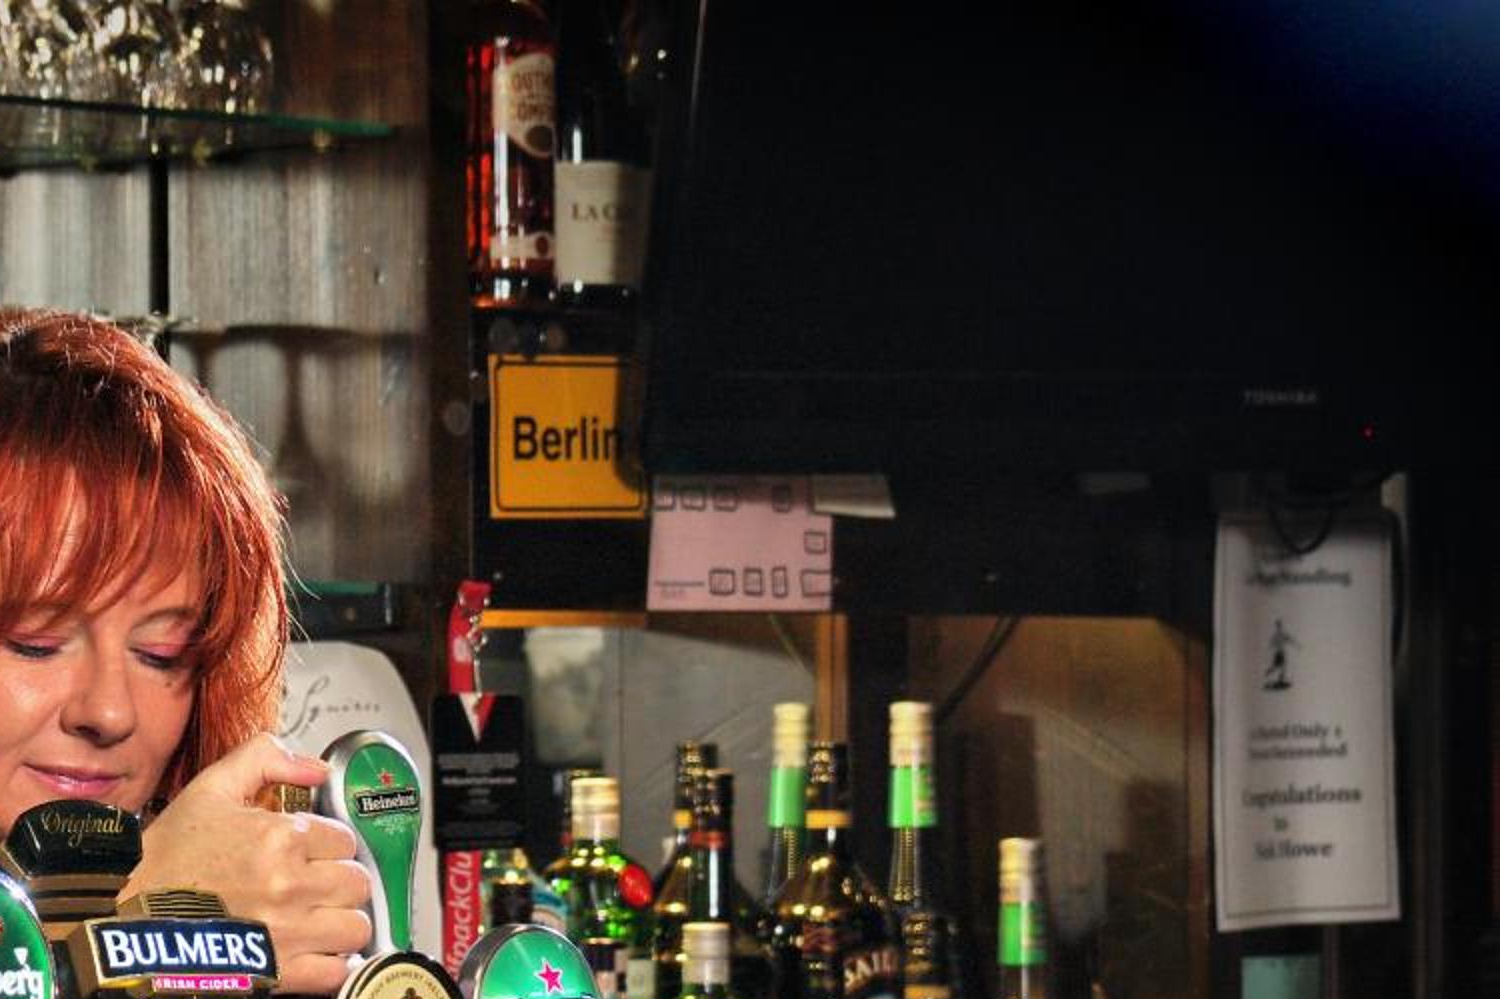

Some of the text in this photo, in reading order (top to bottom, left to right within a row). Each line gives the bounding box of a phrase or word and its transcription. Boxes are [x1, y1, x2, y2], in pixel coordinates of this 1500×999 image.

[512, 416, 619, 461] Berlin
[361, 792, 418, 812] Heineken
[40, 808, 124, 848] Original
[101, 929, 268, 970] BULMERS
[200, 977, 240, 990] CIDER
